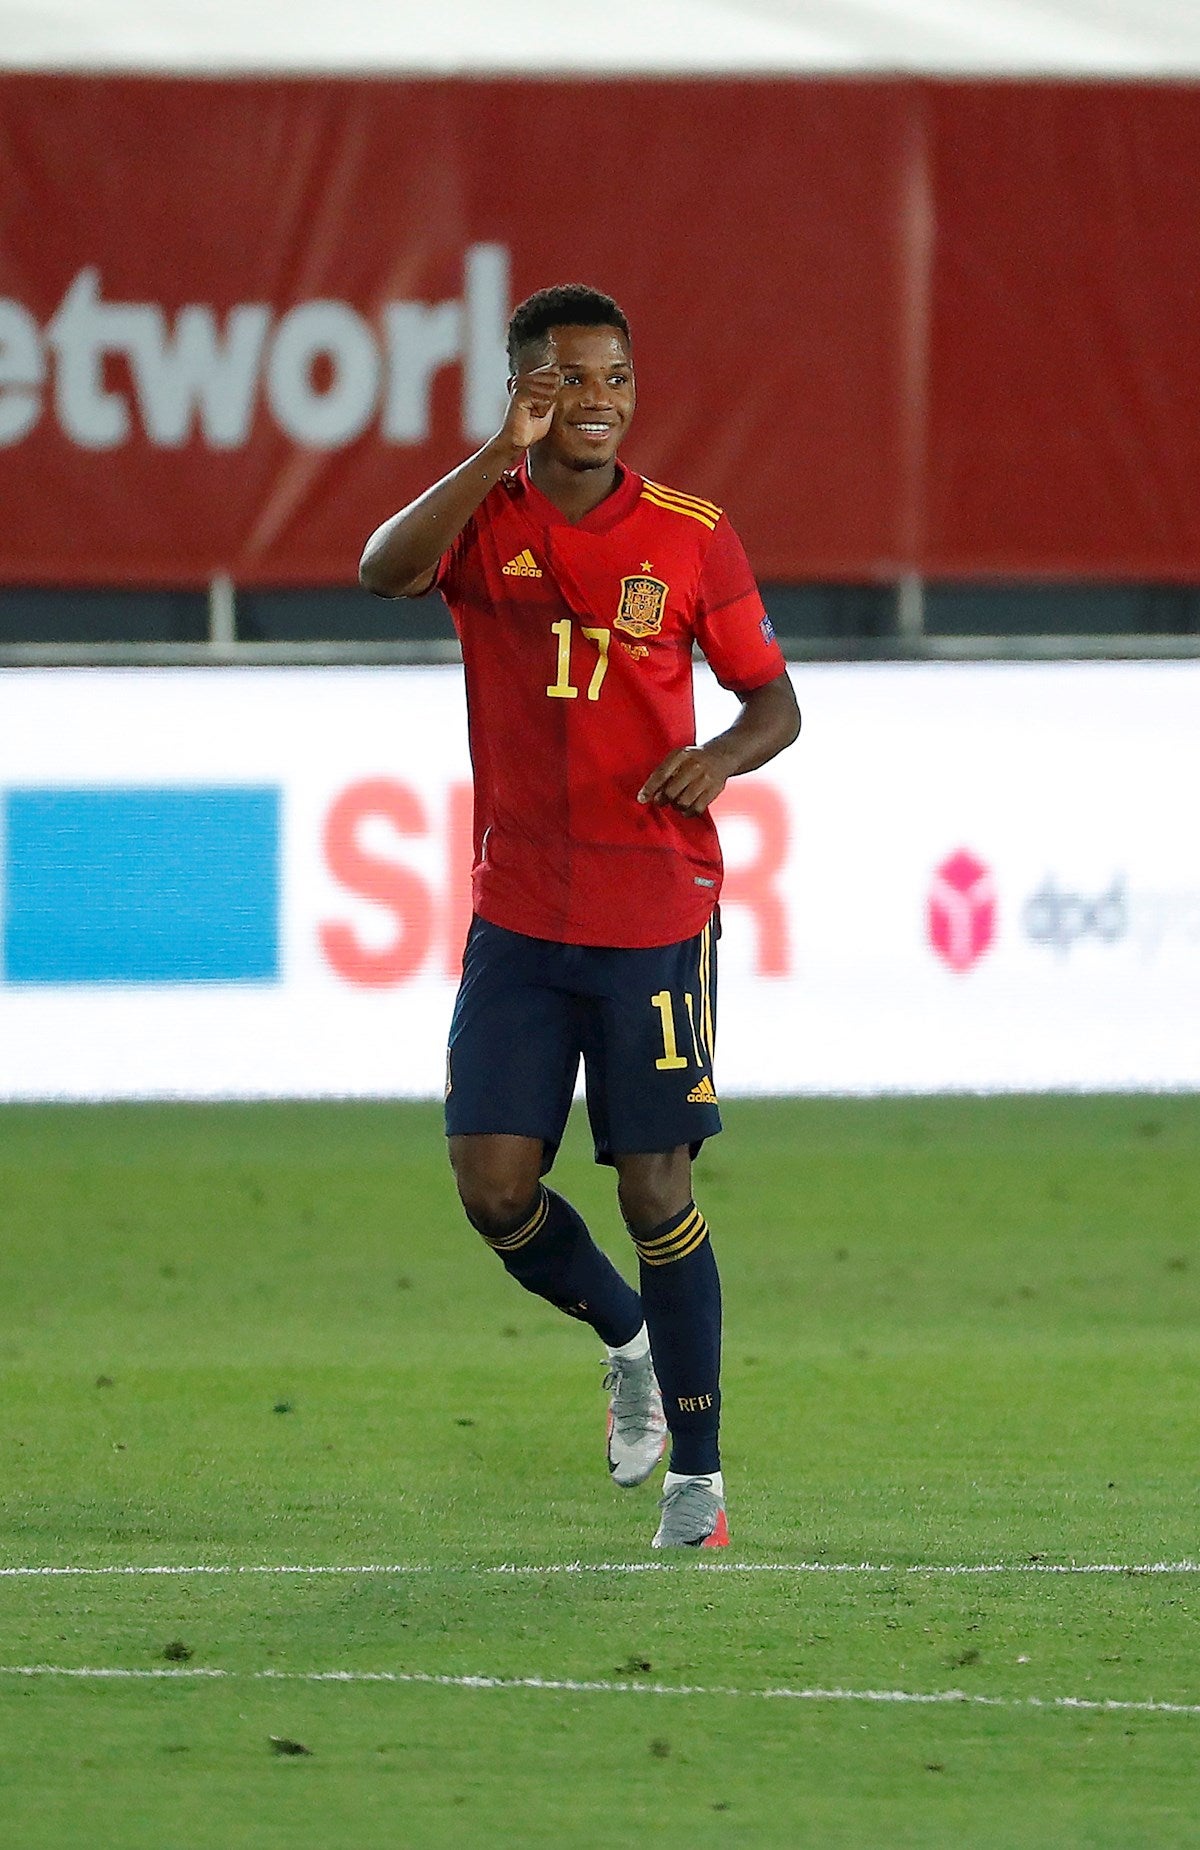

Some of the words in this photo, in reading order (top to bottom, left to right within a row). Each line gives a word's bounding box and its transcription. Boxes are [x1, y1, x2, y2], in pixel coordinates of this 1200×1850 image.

[501, 565, 543, 578] adidas
[546, 618, 611, 702] 17
[316, 772, 795, 992] SR
[677, 1393, 713, 1412] RFEF
